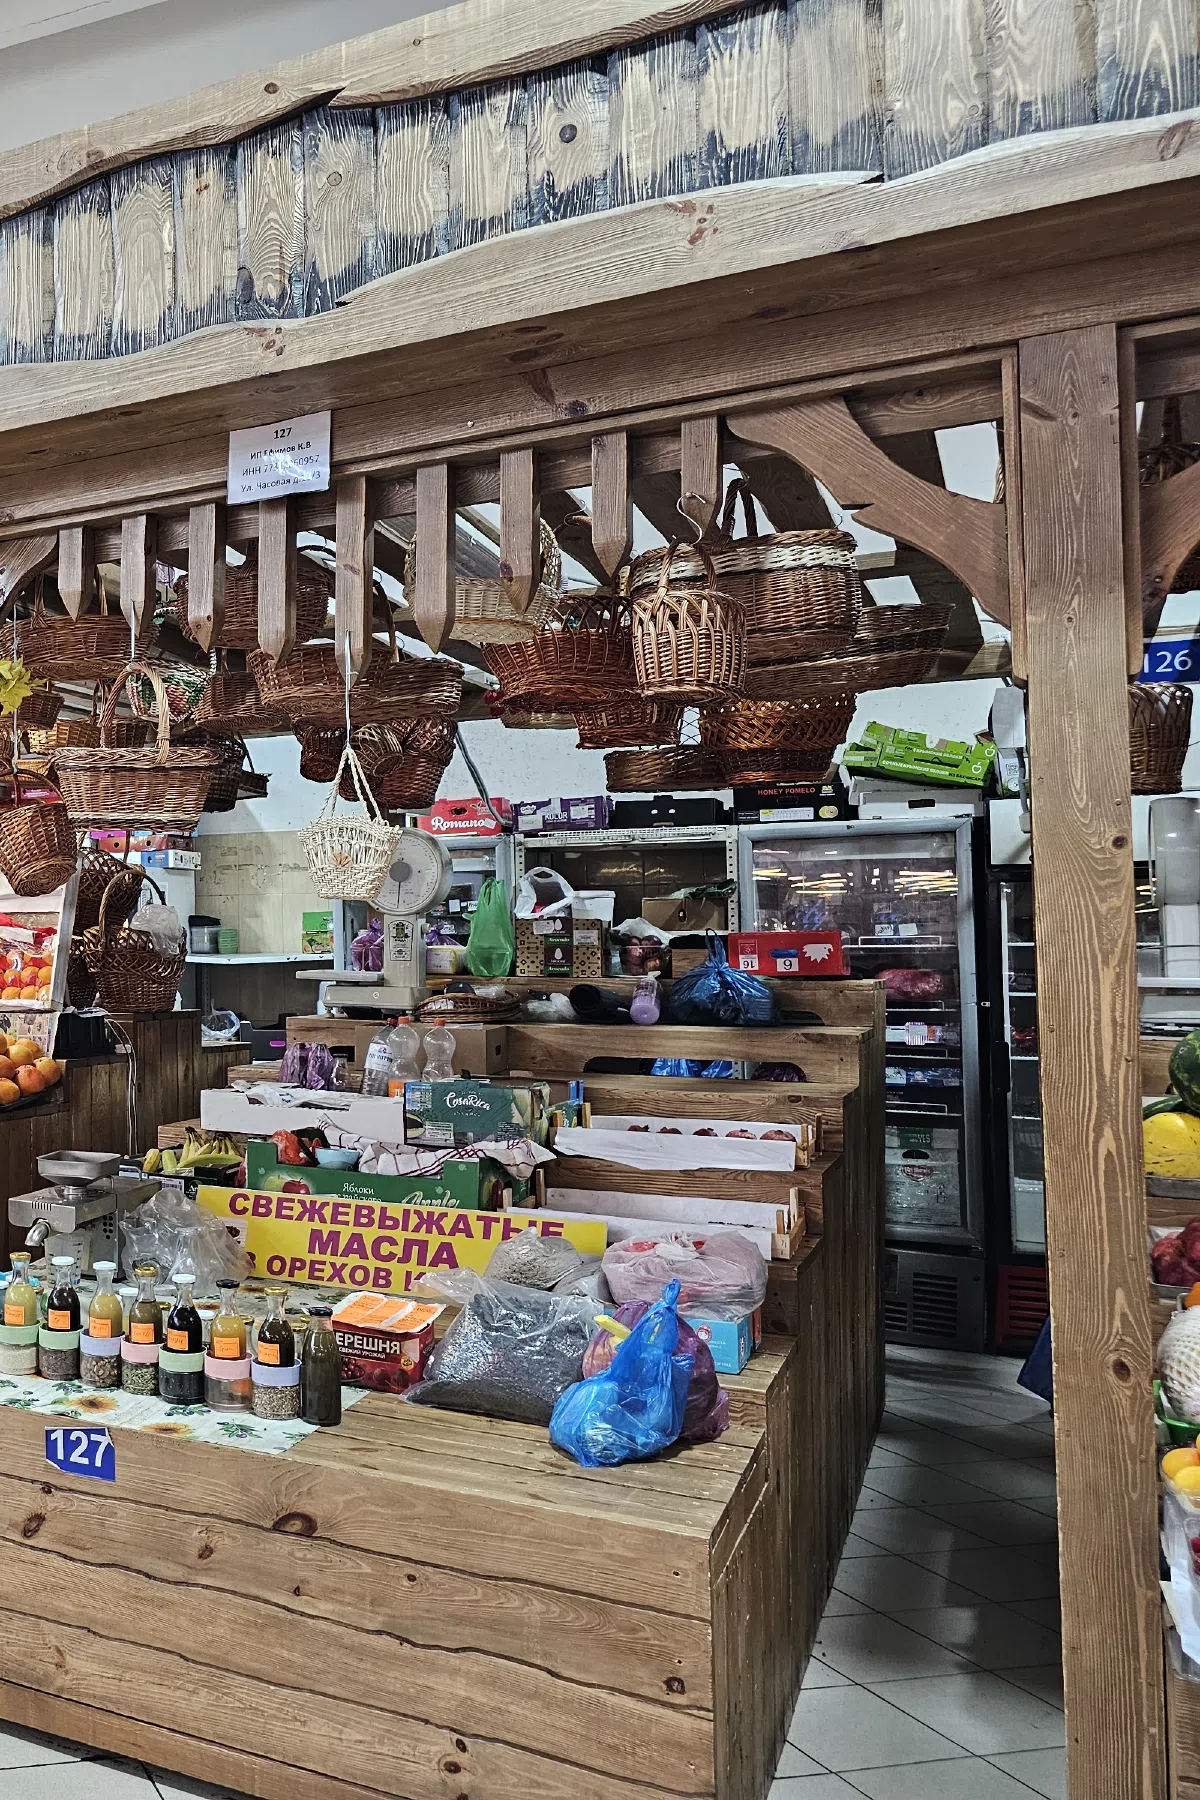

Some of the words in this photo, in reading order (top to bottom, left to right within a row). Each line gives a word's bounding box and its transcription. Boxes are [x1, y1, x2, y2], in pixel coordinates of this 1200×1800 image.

[273, 427, 293, 440] 127
[250, 451, 262, 460] ИП
[242, 466, 261, 477] ИНН
[240, 484, 254, 493] Ул.
[256, 478, 291, 490] Часовая
[1143, 649, 1192, 674] 126
[544, 811, 568, 821] KOLOR
[430, 817, 485, 832] Romano
[342, 1182, 375, 1195] Яблоки
[228, 1191, 565, 1242] СВЕЖЕВЫЖАТЫЕ
[308, 1228, 459, 1269] МАСЛА
[266, 1255, 393, 1288] ОРЕХОВ
[335, 1332, 401, 1355] ЕРЕШНЯ
[338, 1347, 361, 1355] СВЕЖИЙ
[361, 1350, 386, 1359] УРОЖАЙ
[50, 1429, 108, 1467] 127
